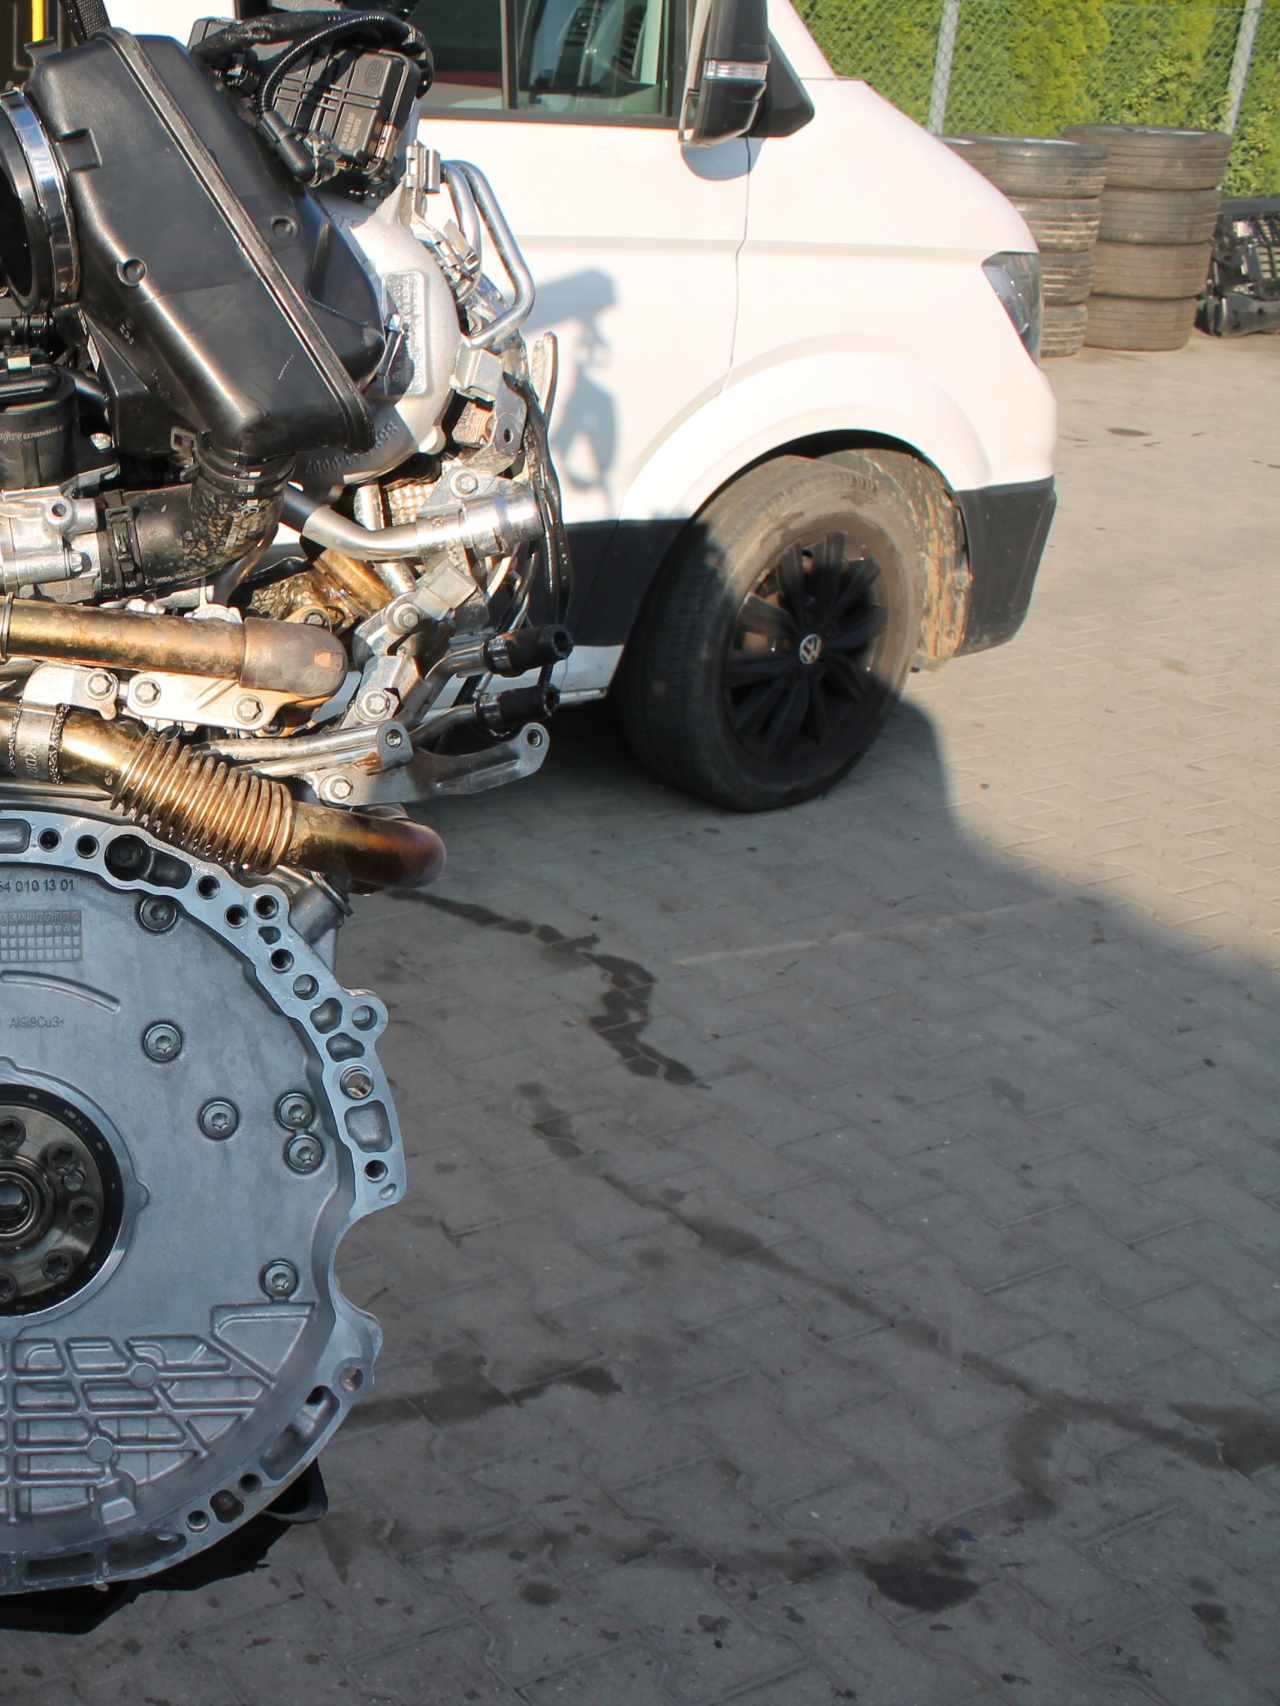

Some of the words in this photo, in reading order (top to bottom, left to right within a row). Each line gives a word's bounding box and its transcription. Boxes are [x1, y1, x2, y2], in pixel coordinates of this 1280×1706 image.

[15, 880, 40, 892] 010
[43, 879, 56, 891] 13
[60, 879, 74, 891] 01
